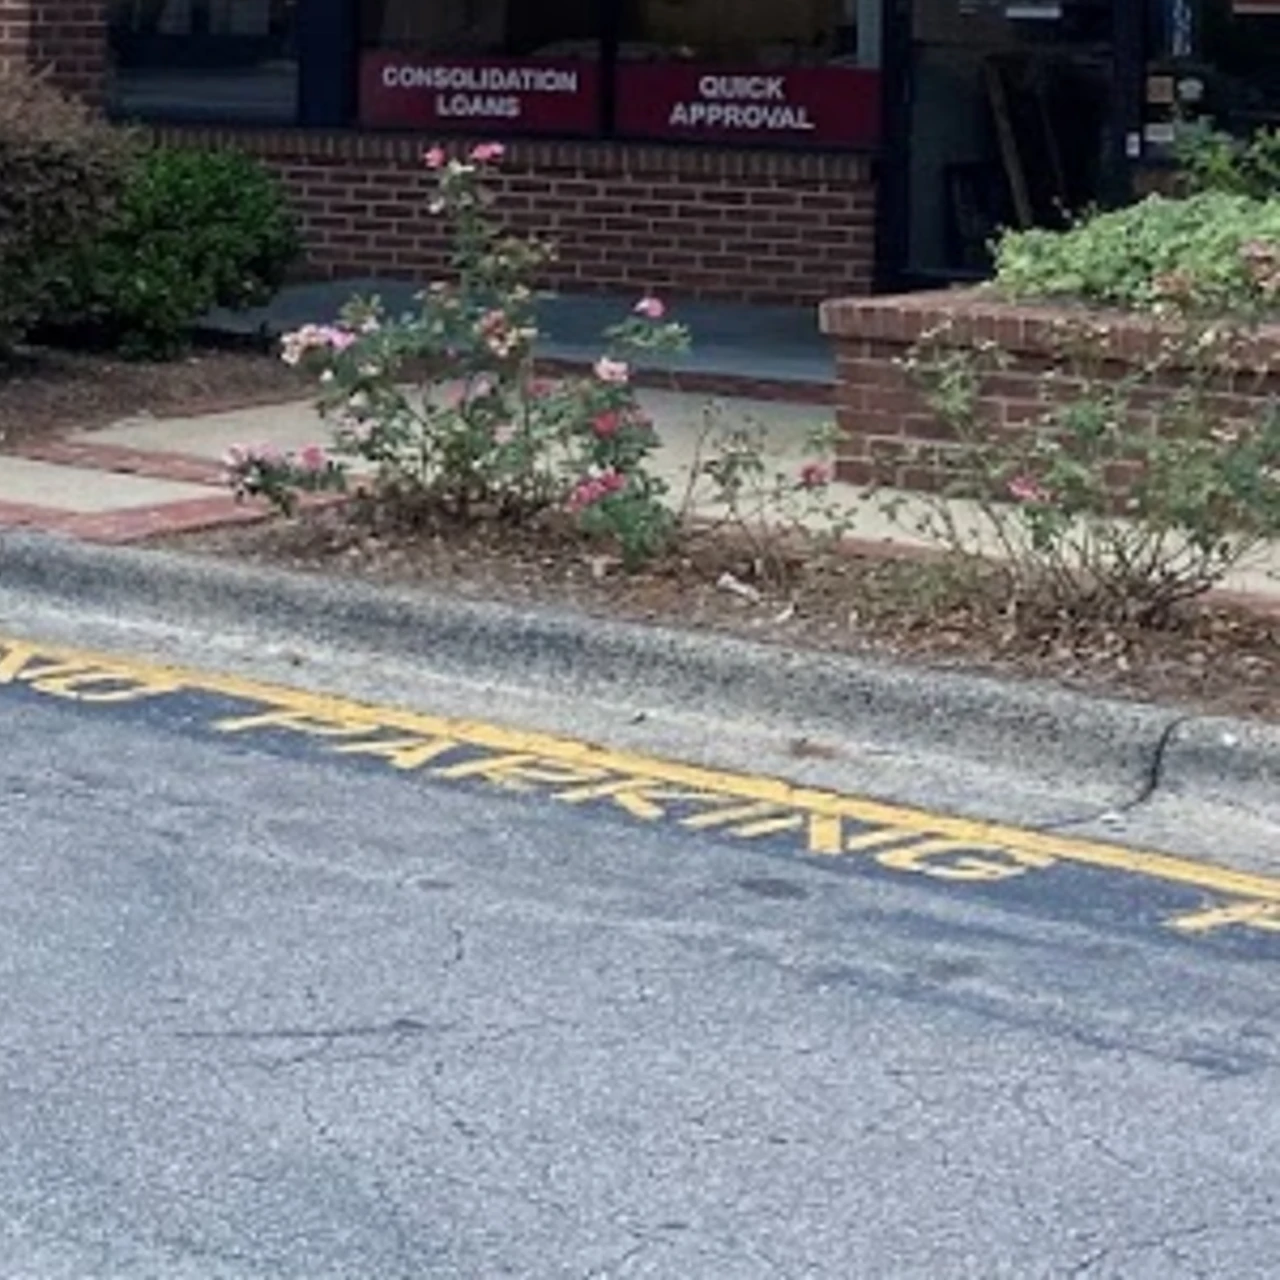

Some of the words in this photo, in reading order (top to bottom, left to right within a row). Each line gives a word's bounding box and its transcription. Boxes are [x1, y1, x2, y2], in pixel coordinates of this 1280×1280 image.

[382, 66, 577, 93] CONSOLIDATION
[698, 75, 785, 100] QUICK
[436, 93, 520, 118] LOANS
[669, 103, 815, 130] APPROVAL
[215, 710, 1056, 881] PARKING
